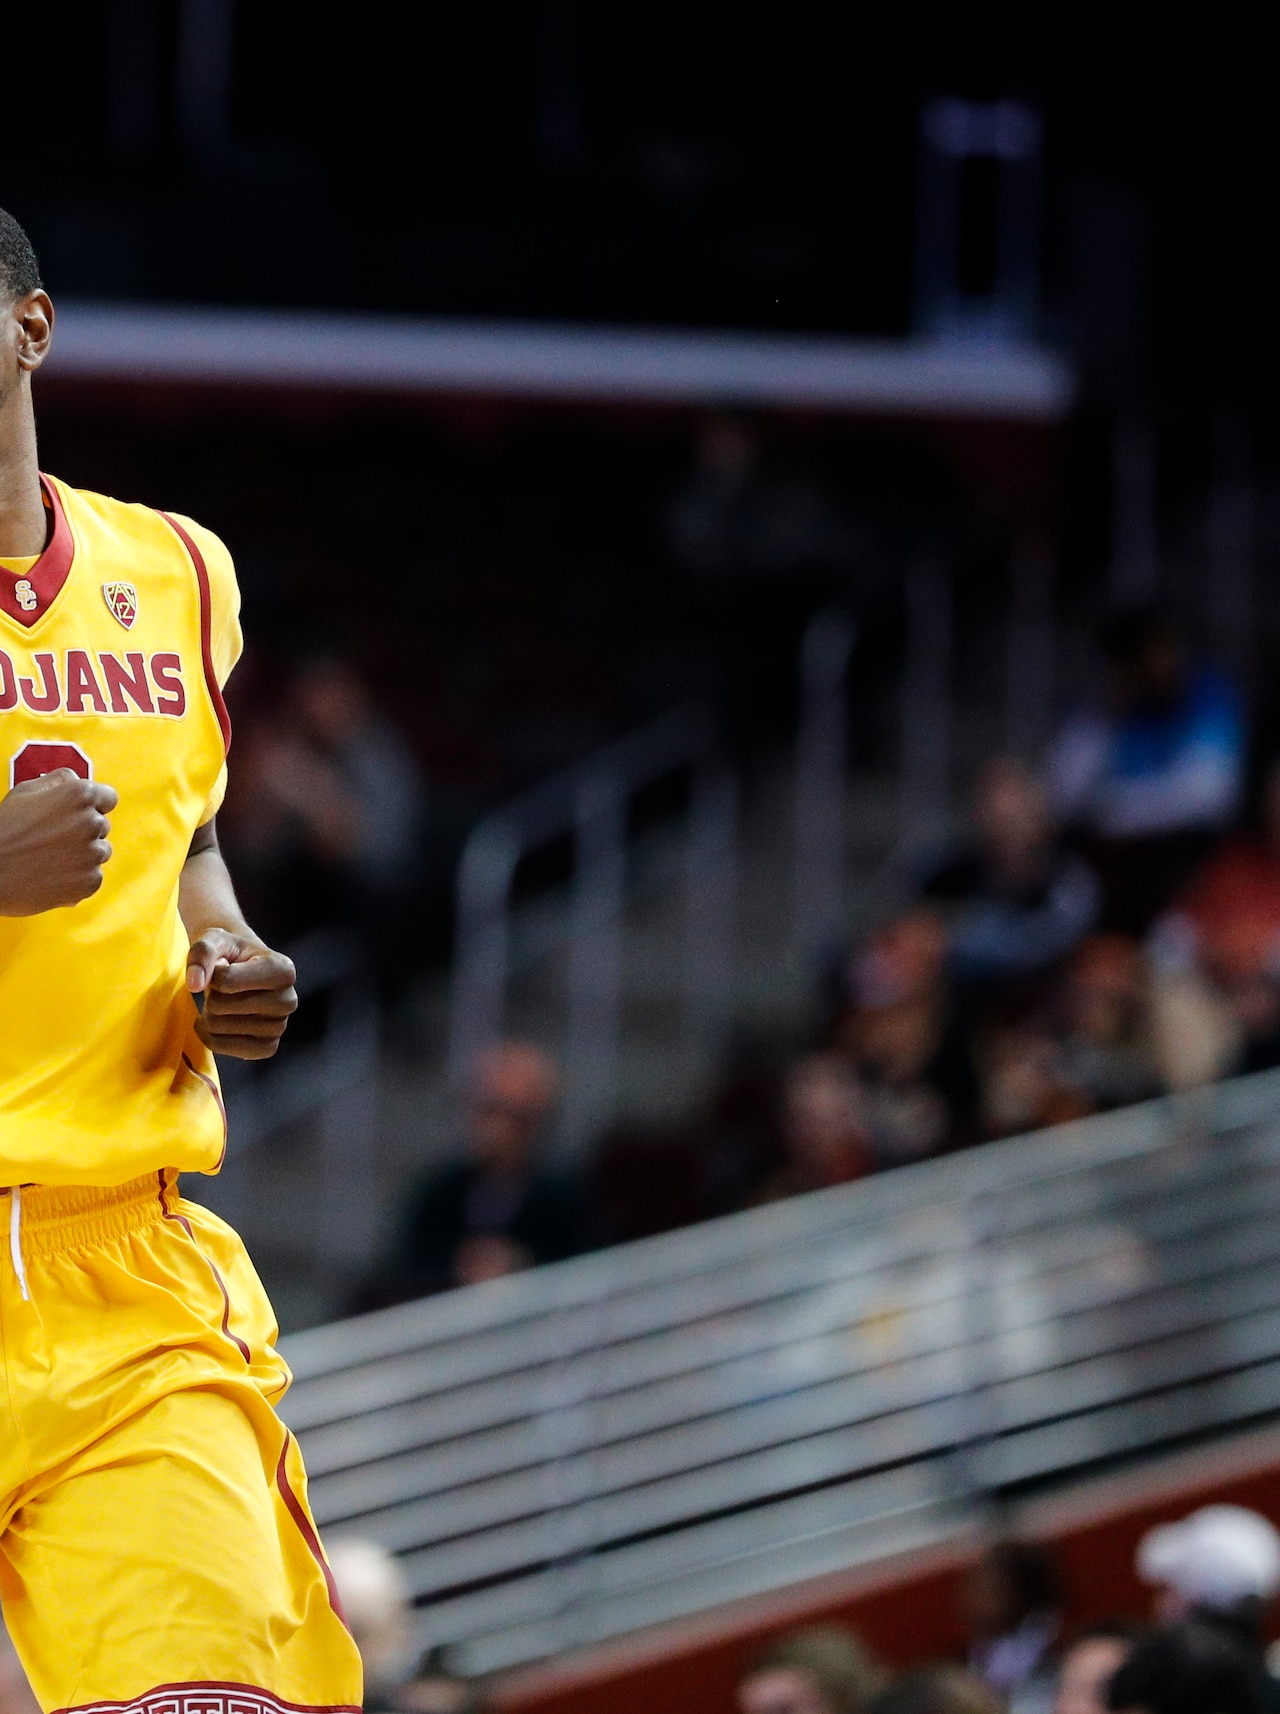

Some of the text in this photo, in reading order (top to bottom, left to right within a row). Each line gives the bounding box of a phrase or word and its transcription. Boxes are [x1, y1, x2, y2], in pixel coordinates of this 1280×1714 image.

[15, 580, 37, 611] SC
[106, 583, 135, 609] PAC
[115, 602, 134, 620] 12
